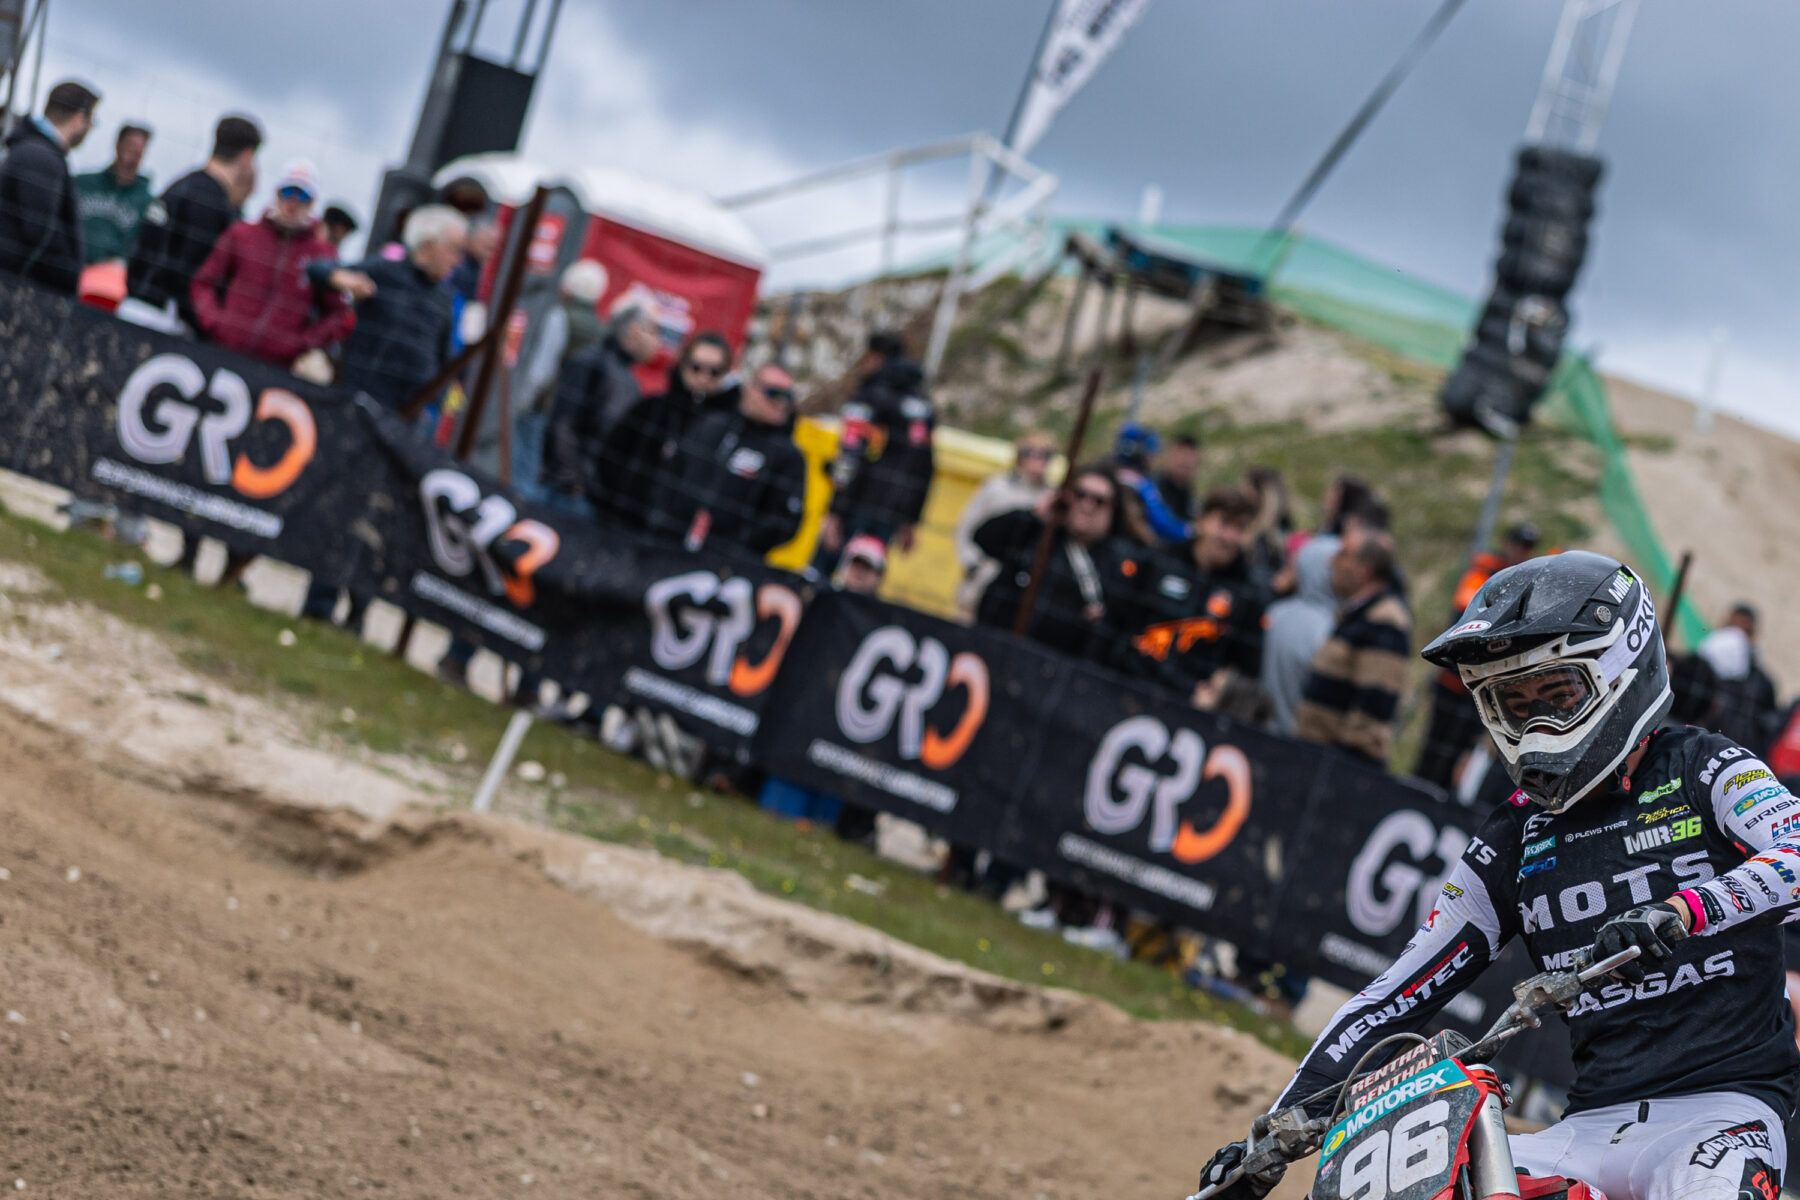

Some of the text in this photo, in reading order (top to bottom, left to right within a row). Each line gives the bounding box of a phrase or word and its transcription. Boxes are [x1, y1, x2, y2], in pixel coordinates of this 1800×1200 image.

[1575, 827, 1603, 841] PLEWS
[1518, 850, 1715, 935] MOTS
[1346, 1068, 1446, 1138] MOTOREX
